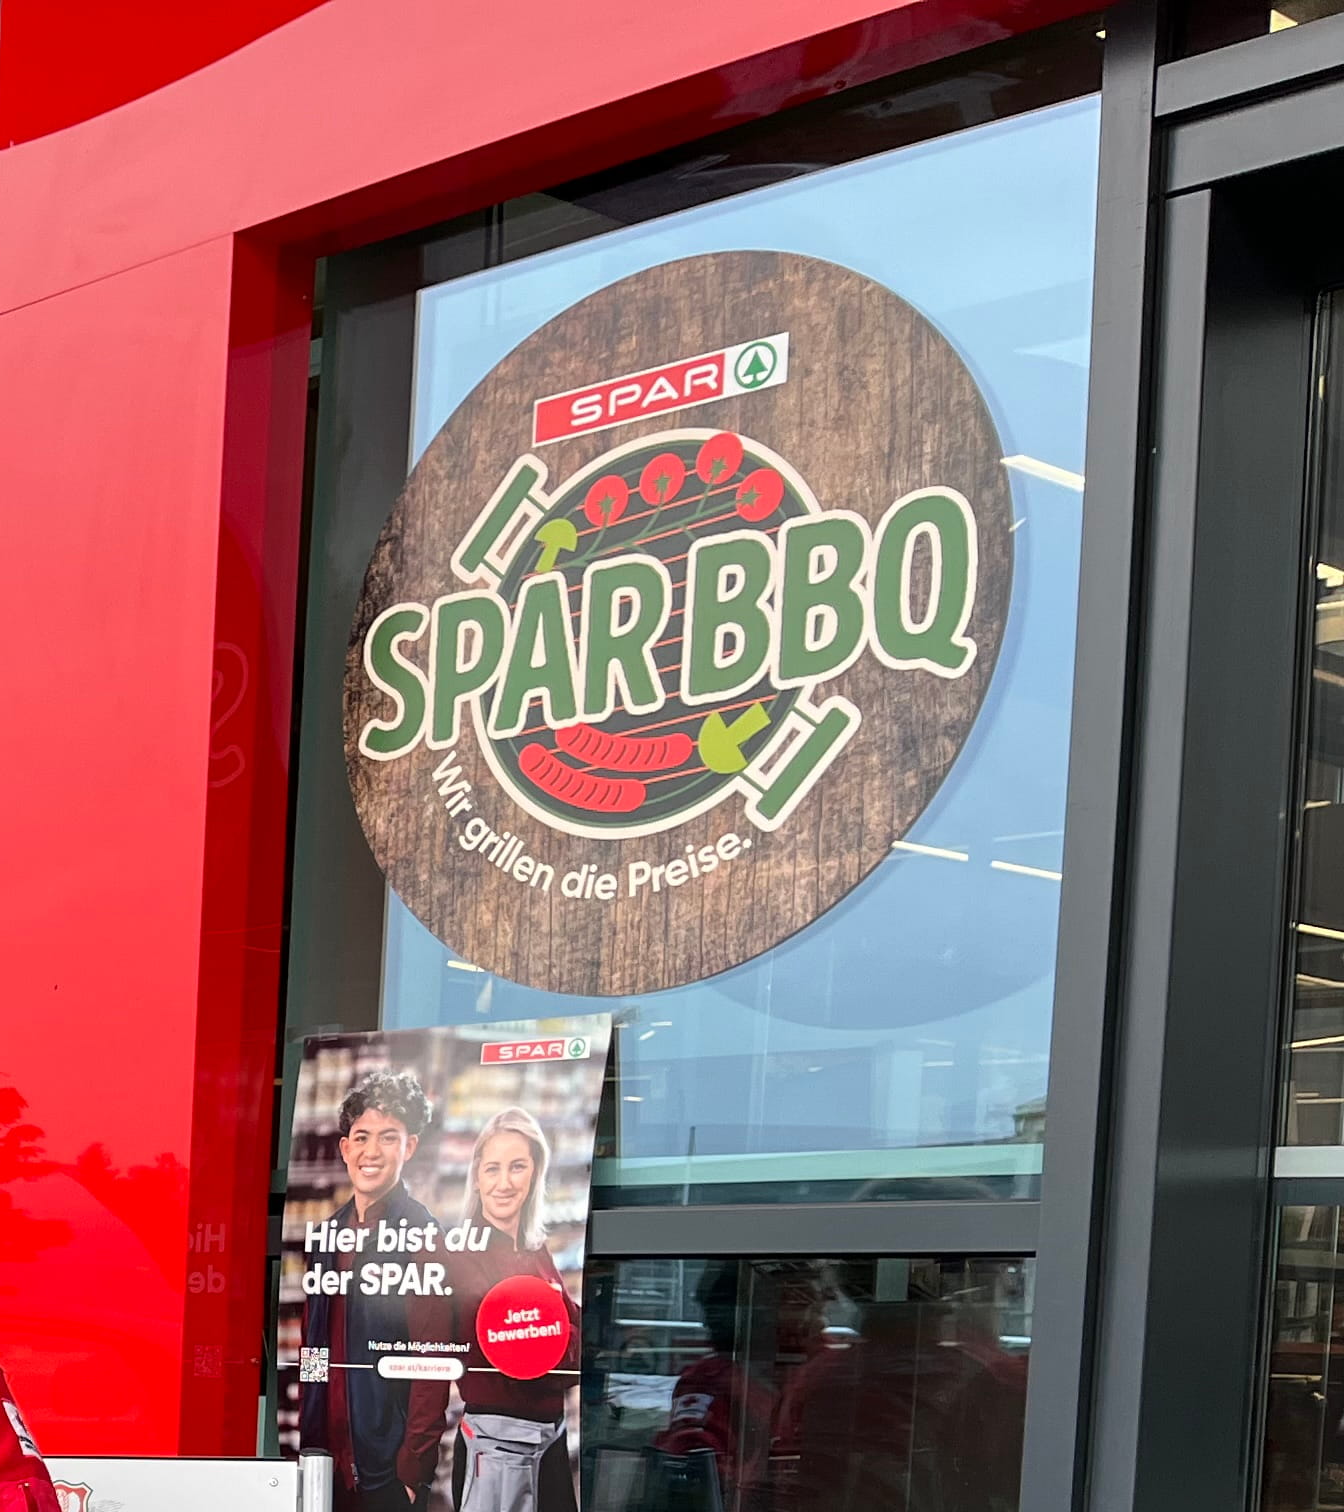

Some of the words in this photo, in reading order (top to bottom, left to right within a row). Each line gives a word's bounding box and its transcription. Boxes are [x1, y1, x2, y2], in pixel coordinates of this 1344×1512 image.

[569, 361, 719, 427] SPAR
[359, 552, 673, 761] SPAR
[682, 486, 978, 708] BBQ
[431, 750, 474, 819] Wir
[458, 813, 555, 896] grillen
[560, 863, 618, 900] die
[628, 834, 752, 898] Preise.
[498, 1041, 563, 1060] SPAR
[303, 1220, 370, 1254] Hier
[376, 1220, 437, 1254] bist
[445, 1218, 491, 1254] du
[301, 1262, 353, 1296] der
[359, 1261, 453, 1296] SPAR.
[487, 1321, 561, 1343] bewerben!
[504, 1307, 541, 1326] Jetzt
[367, 1340, 392, 1352] Nutze
[392, 1341, 407, 1352] die
[407, 1340, 470, 1354] Möglichkeiten!
